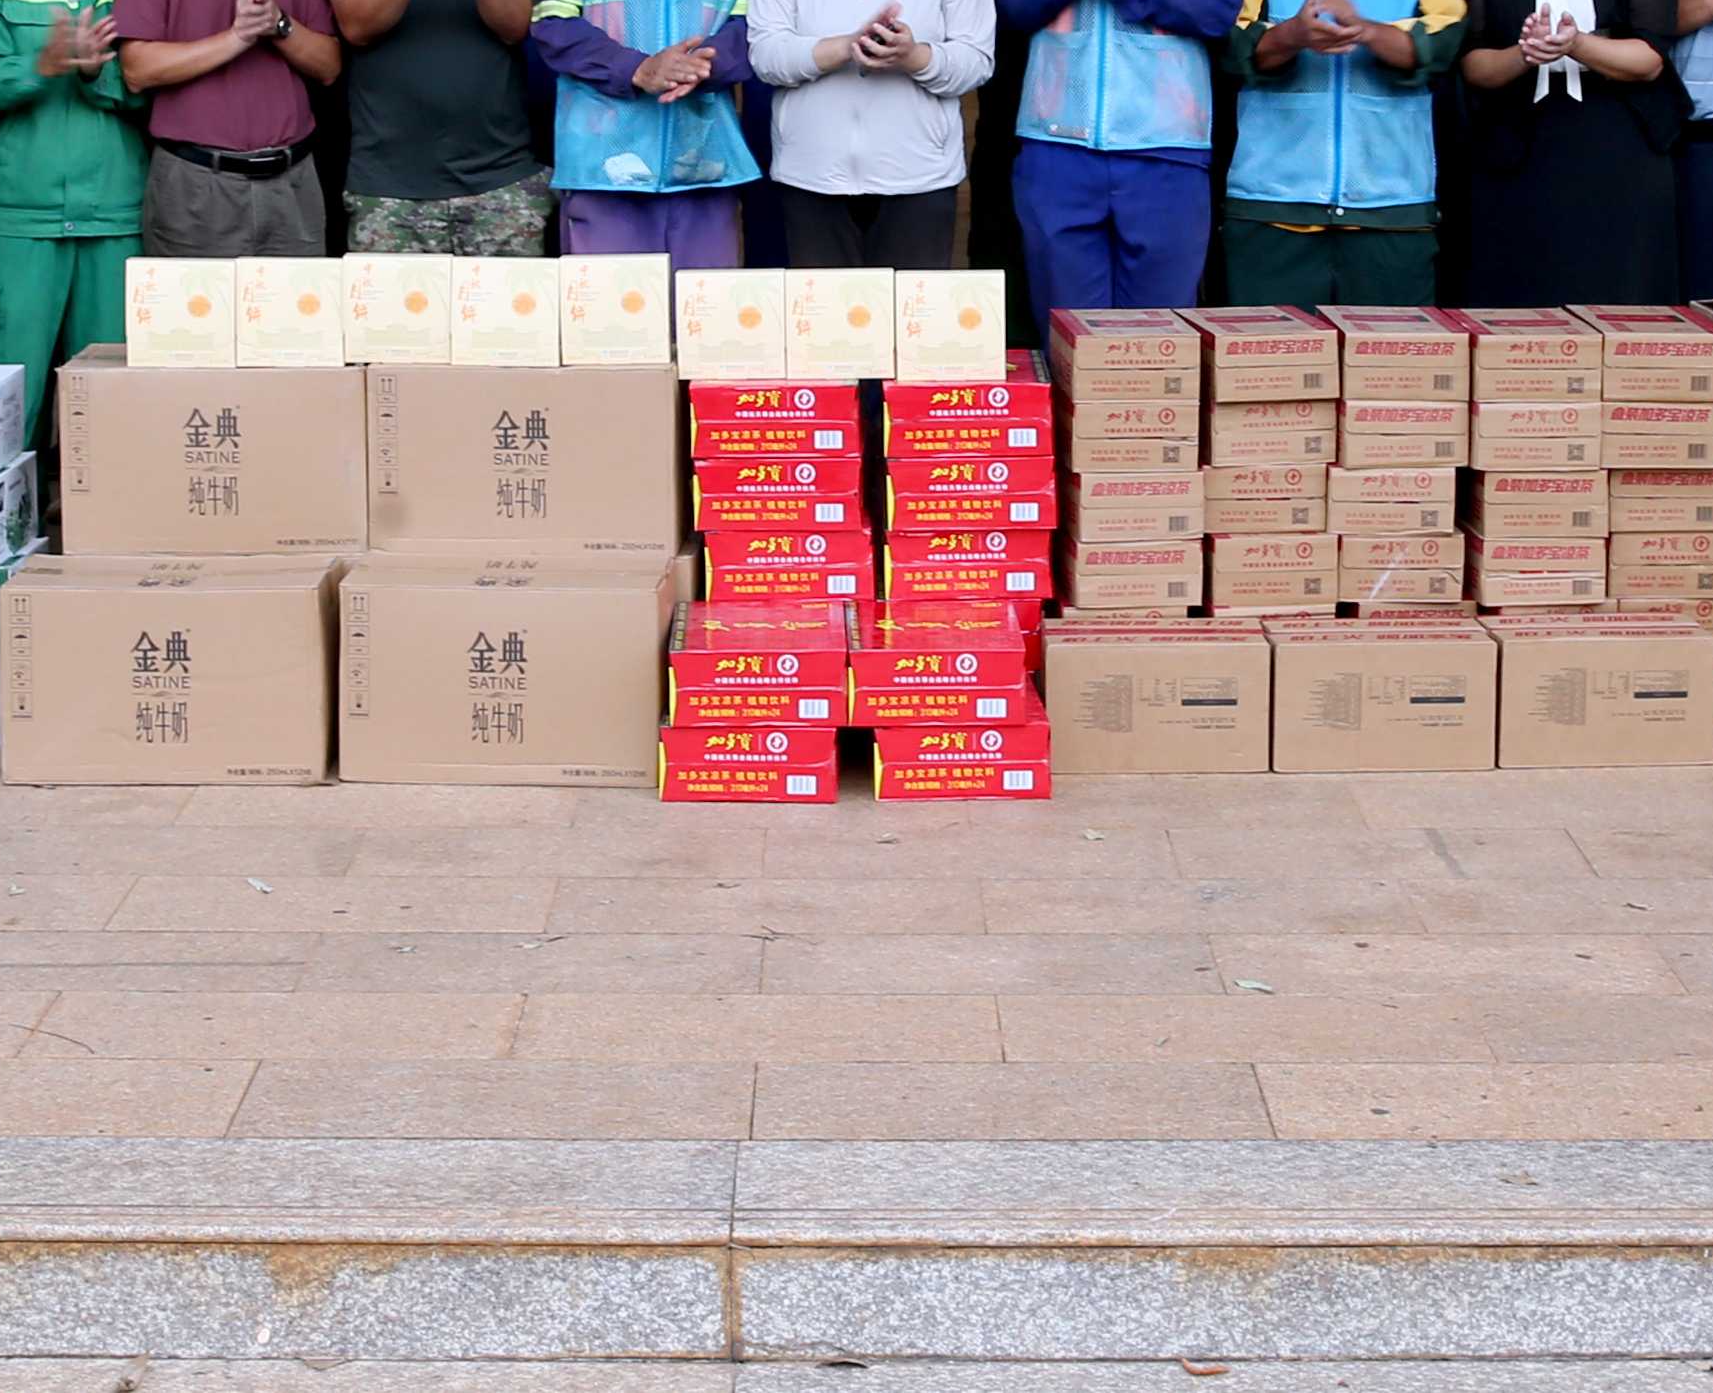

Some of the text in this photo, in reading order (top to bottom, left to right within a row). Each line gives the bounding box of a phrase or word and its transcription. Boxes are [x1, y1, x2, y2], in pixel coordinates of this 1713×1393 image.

[184, 408, 241, 448] 金典
[493, 411, 549, 450] 金典
[185, 451, 240, 464] SATINE
[494, 453, 549, 466] SATINE
[189, 477, 238, 515] 纯牛奶
[497, 478, 546, 518] 纯牛奶
[132, 632, 191, 673] 金典
[468, 632, 527, 674] 金典
[133, 676, 190, 689] SATINE
[469, 676, 526, 690] SATINE
[136, 702, 187, 743] 纯牛奶
[472, 703, 523, 743] 纯牛奶
